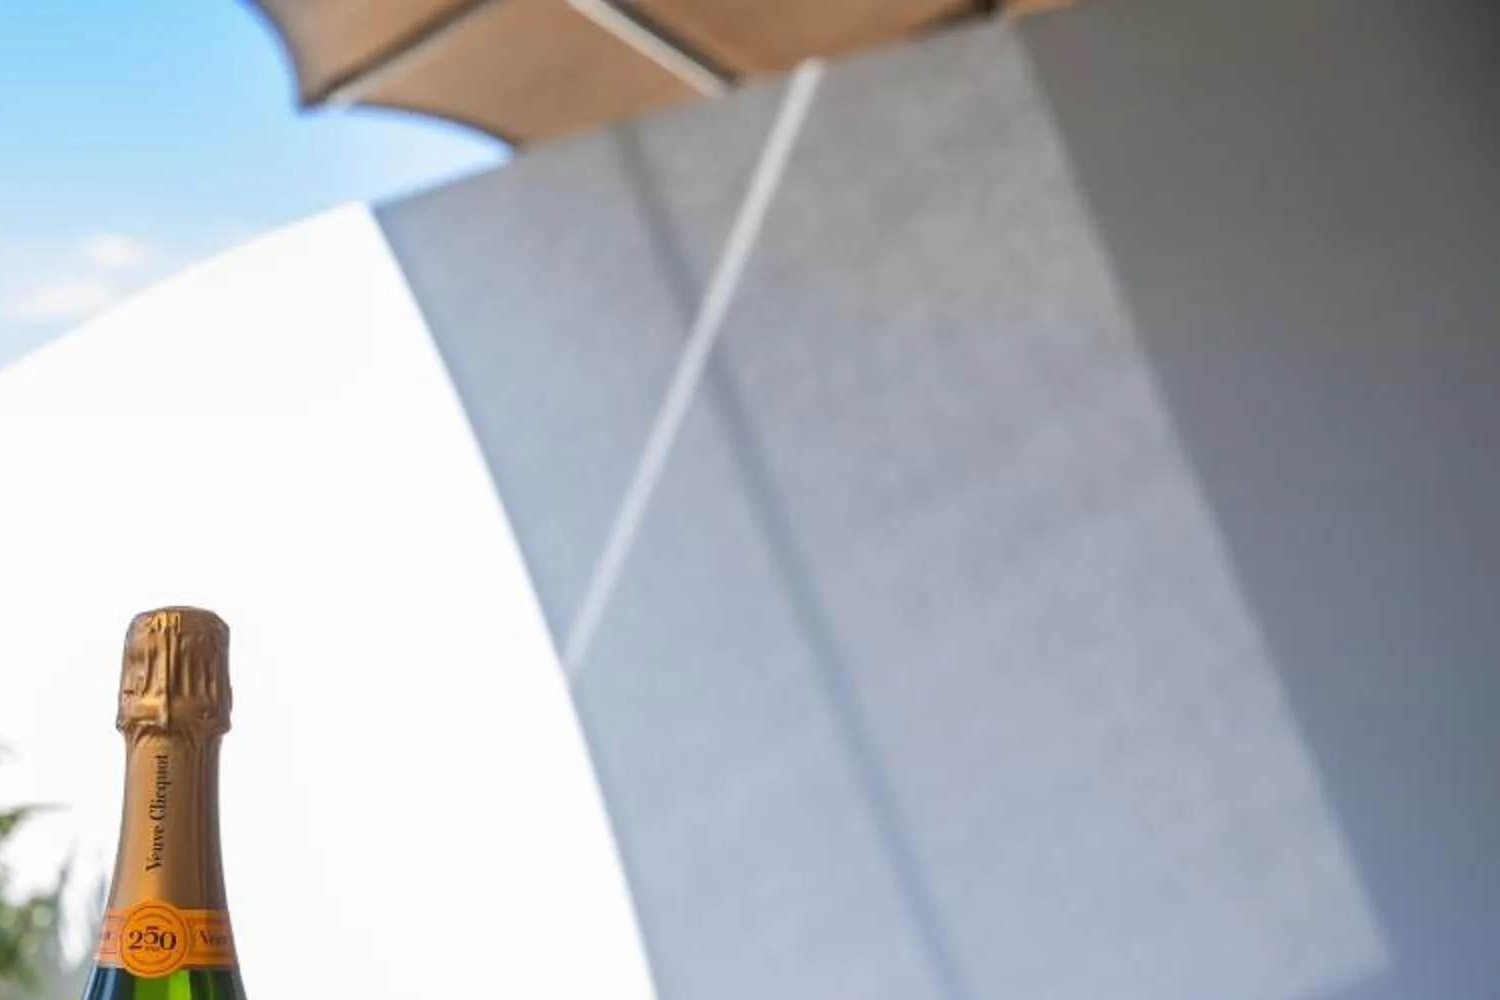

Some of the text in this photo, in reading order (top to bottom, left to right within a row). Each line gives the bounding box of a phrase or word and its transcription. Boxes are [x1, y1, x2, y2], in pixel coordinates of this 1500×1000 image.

[145, 754, 172, 872] Veuve Clicquot
[128, 924, 177, 951] 250
